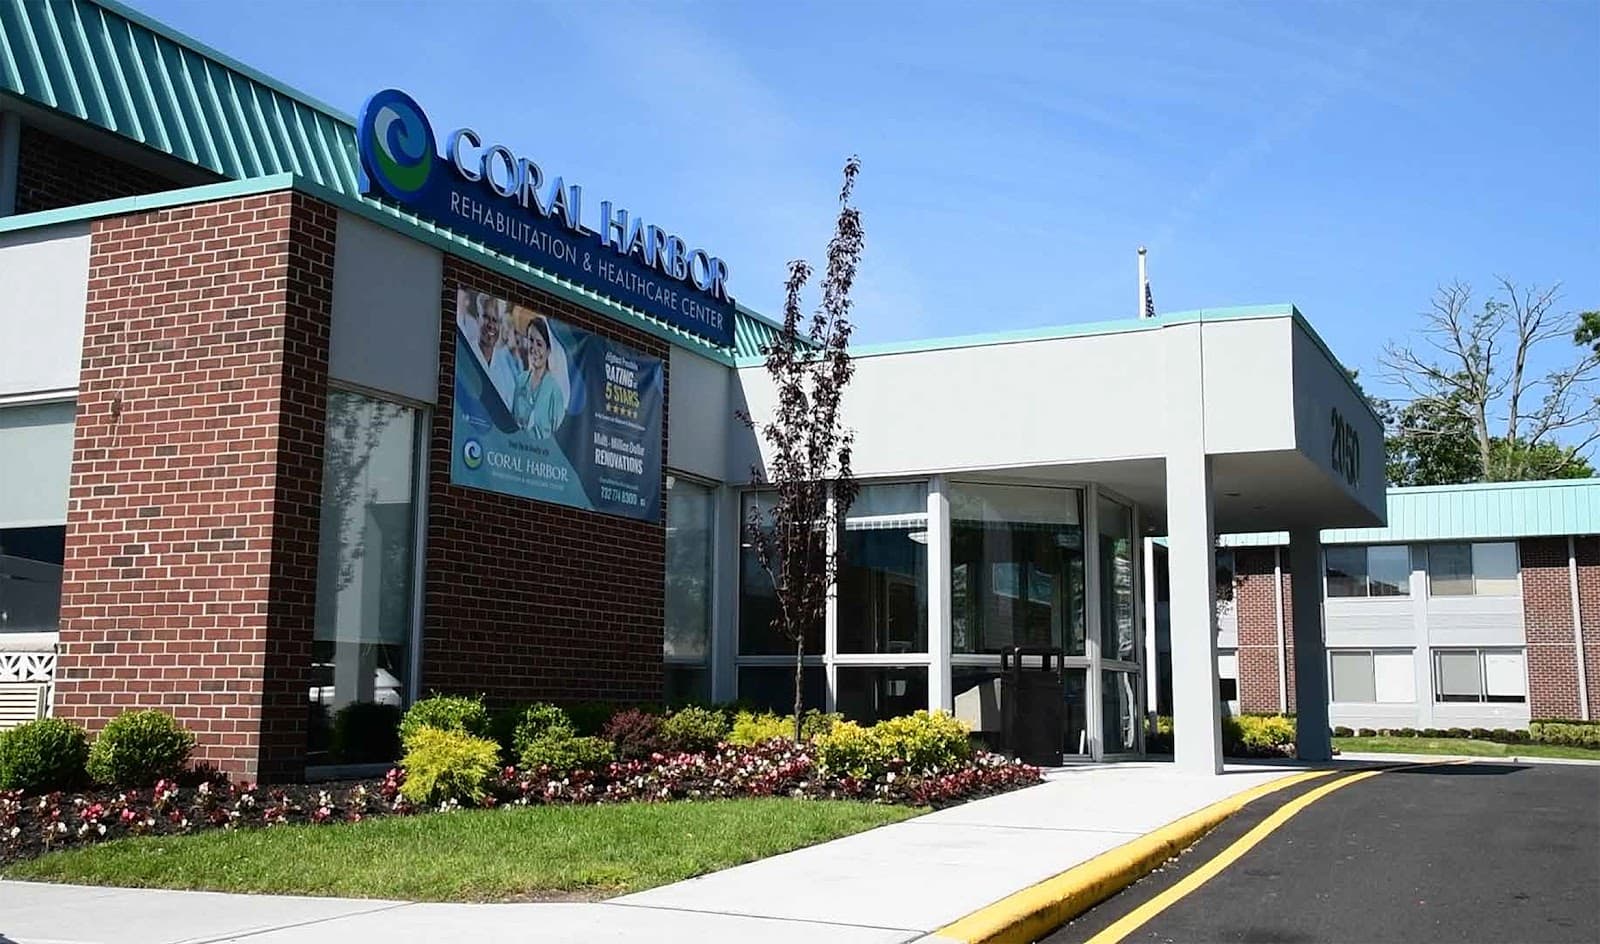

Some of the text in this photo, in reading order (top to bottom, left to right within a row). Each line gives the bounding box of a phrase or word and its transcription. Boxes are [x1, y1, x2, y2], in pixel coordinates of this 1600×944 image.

[447, 128, 731, 303] CORAL HARBOR
[451, 191, 723, 330] REHABILITATION & HEALTHCARE CENTER
[605, 363, 633, 388] RATING
[605, 381, 640, 408] 5 STARS
[595, 448, 643, 475] RENOVATIONS
[1331, 407, 1360, 489] 2050
[487, 451, 523, 472] CORAL
[526, 460, 568, 481] HARBOR
